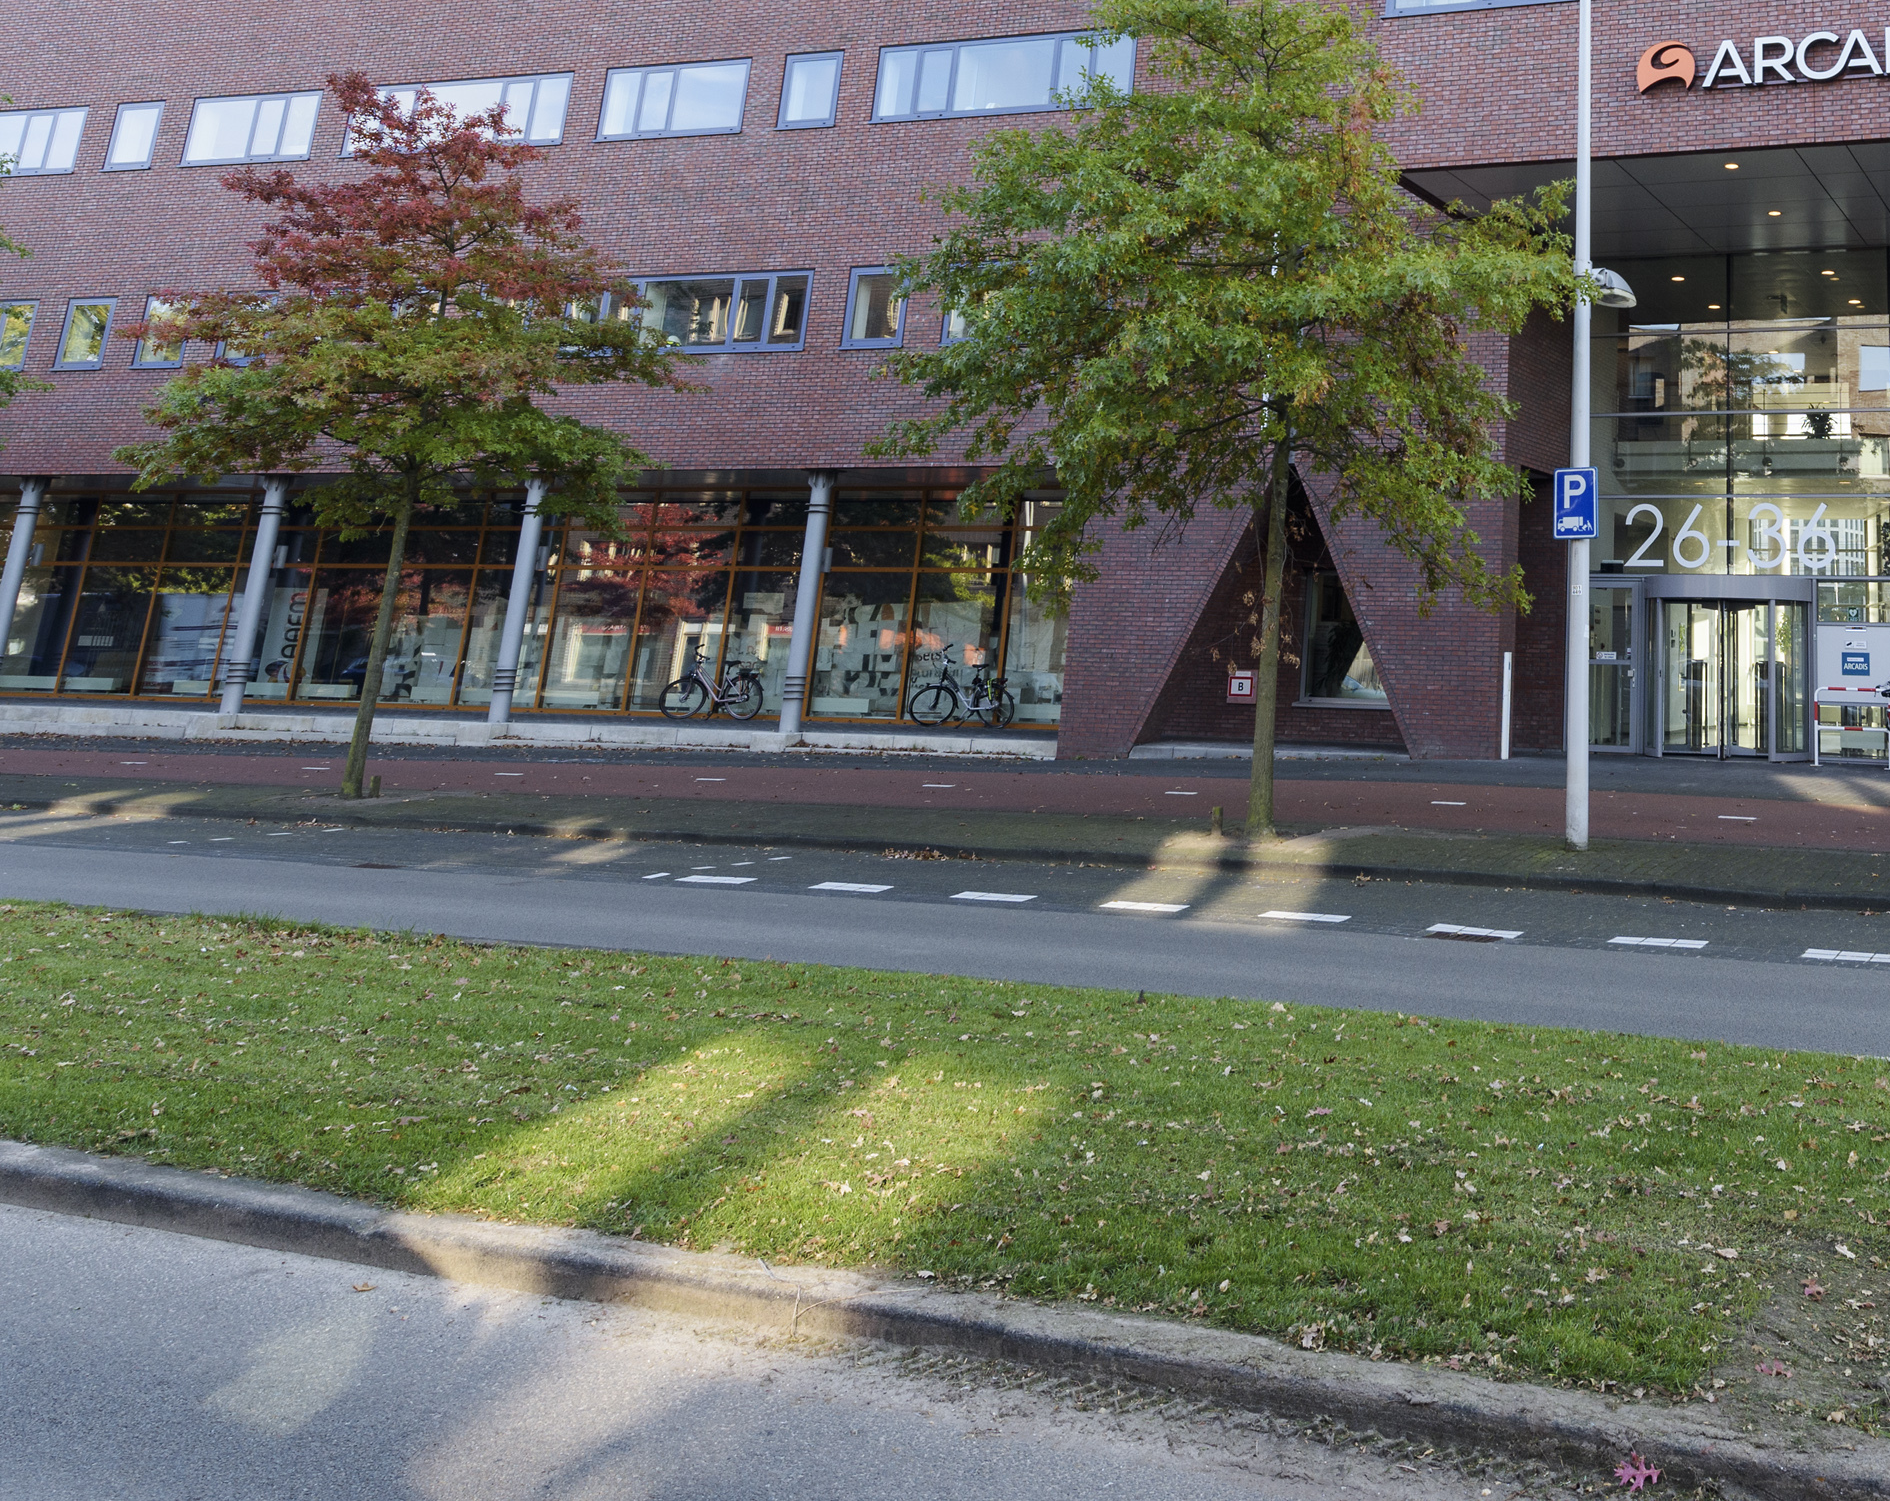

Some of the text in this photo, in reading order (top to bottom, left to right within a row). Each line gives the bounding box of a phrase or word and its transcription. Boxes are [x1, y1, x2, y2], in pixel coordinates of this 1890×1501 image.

[1563, 474, 1587, 509] P
[1623, 502, 1837, 569] 26-36
[1843, 662, 1868, 670] ARCADIS
[1237, 681, 1244, 692] B
